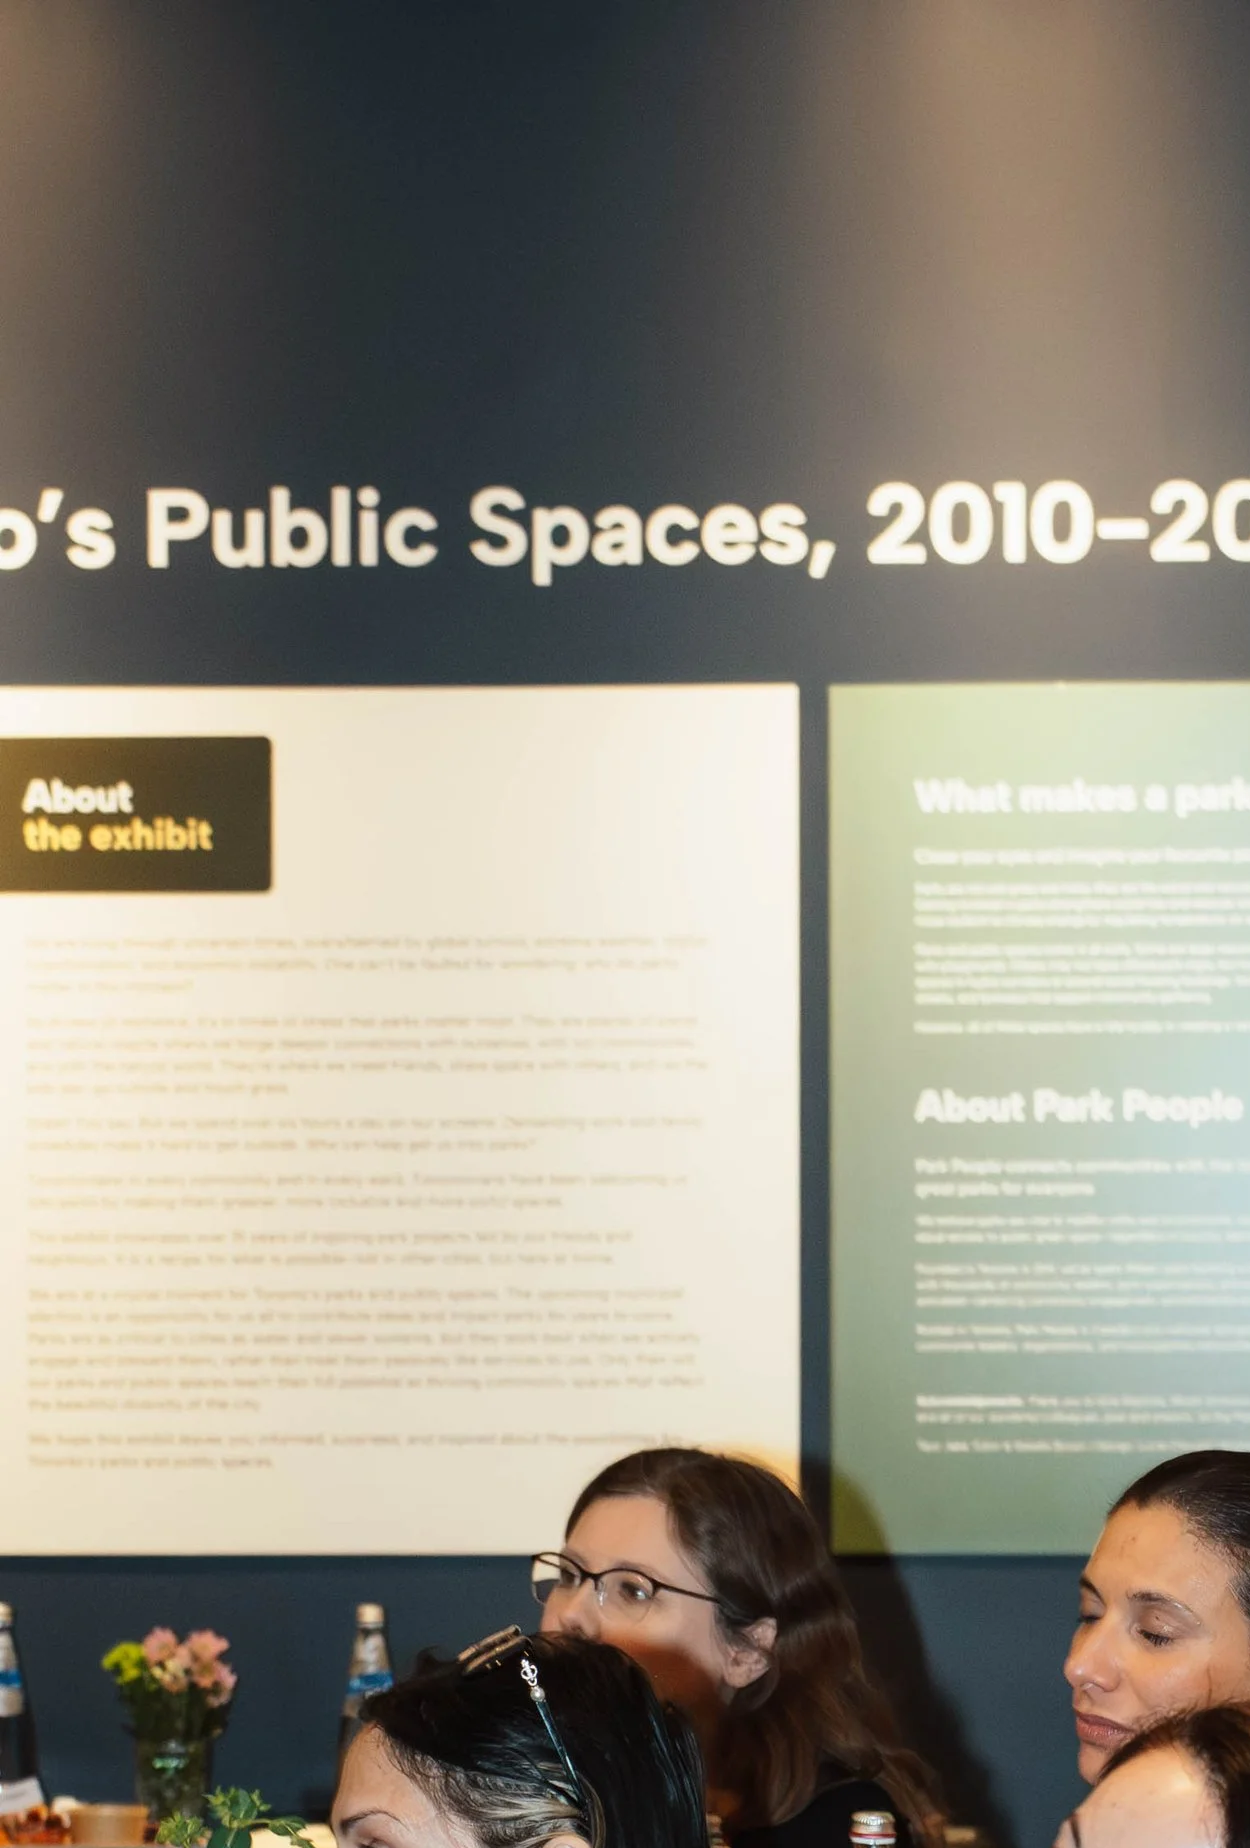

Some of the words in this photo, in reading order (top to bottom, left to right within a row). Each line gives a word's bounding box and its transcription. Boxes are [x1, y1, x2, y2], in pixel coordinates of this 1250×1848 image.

[147, 486, 437, 569] Public
[471, 486, 836, 586] Spaces,
[22, 777, 133, 814] About
[914, 778, 1012, 813] What
[1019, 776, 1136, 813] makes
[1144, 784, 1167, 812] a
[22, 817, 82, 852] the
[89, 817, 213, 852] exhibit
[914, 1088, 1026, 1123] About
[1033, 1087, 1114, 1123] Park
[1122, 1088, 1244, 1129] People
